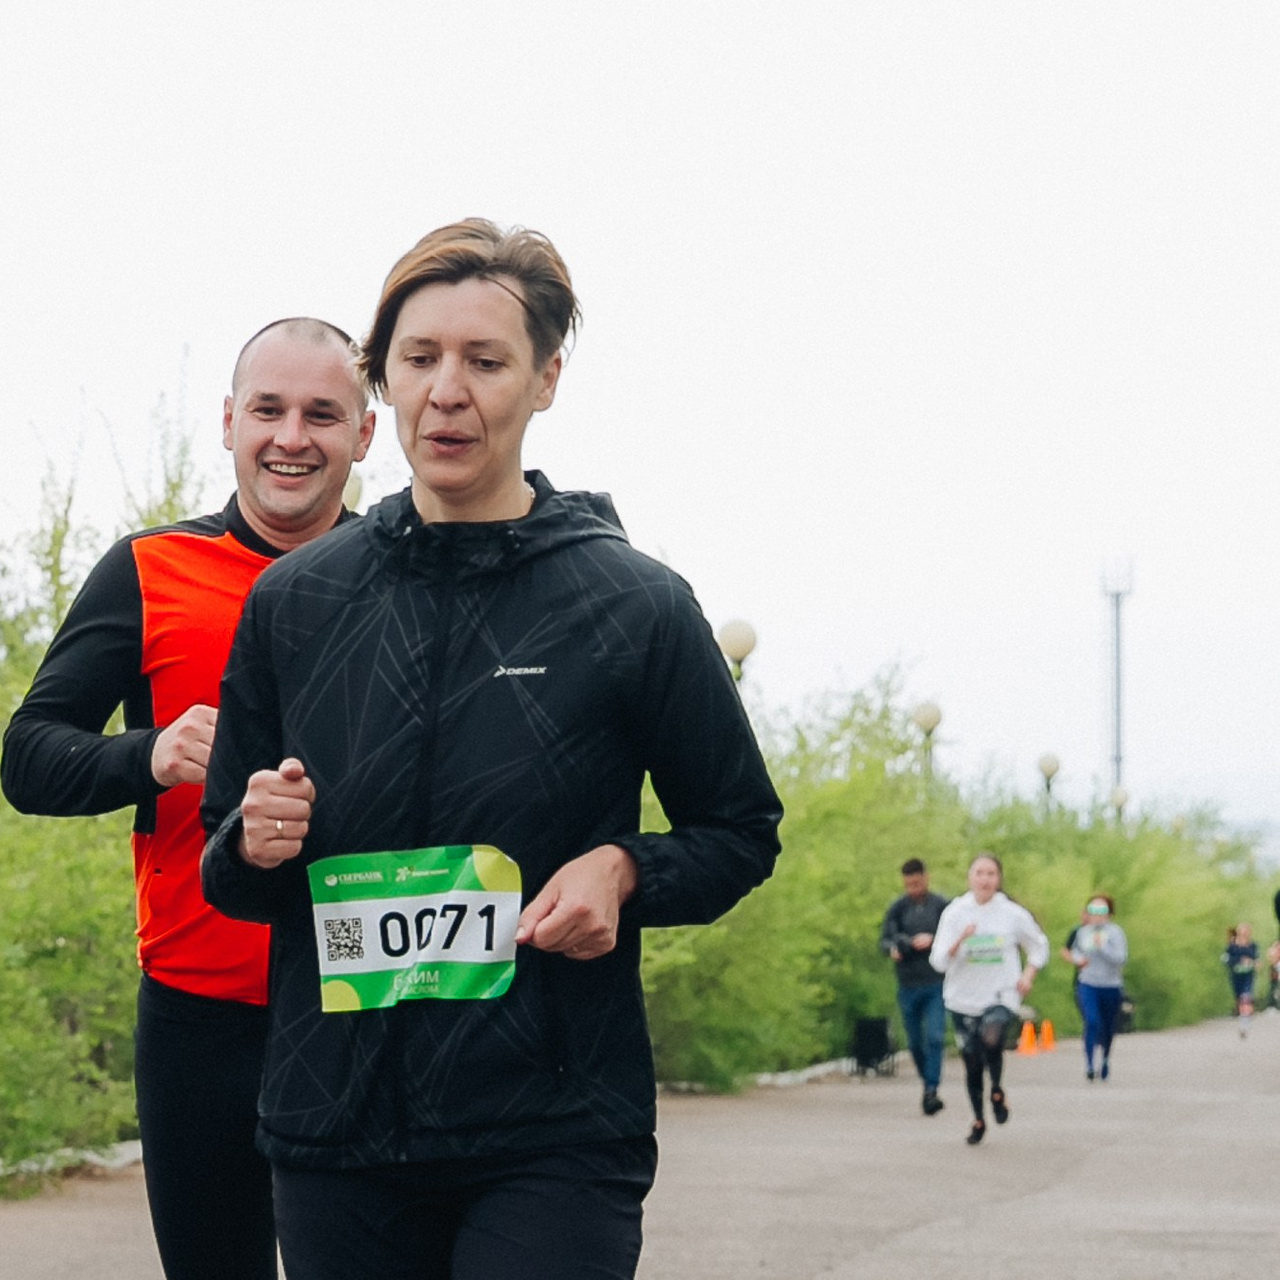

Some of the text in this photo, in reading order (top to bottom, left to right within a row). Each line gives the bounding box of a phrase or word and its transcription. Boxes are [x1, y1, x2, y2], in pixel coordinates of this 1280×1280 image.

[505, 666, 547, 676] DEMIX
[338, 871, 382, 883] СБЕРБАНК
[379, 904, 496, 958] 0071
